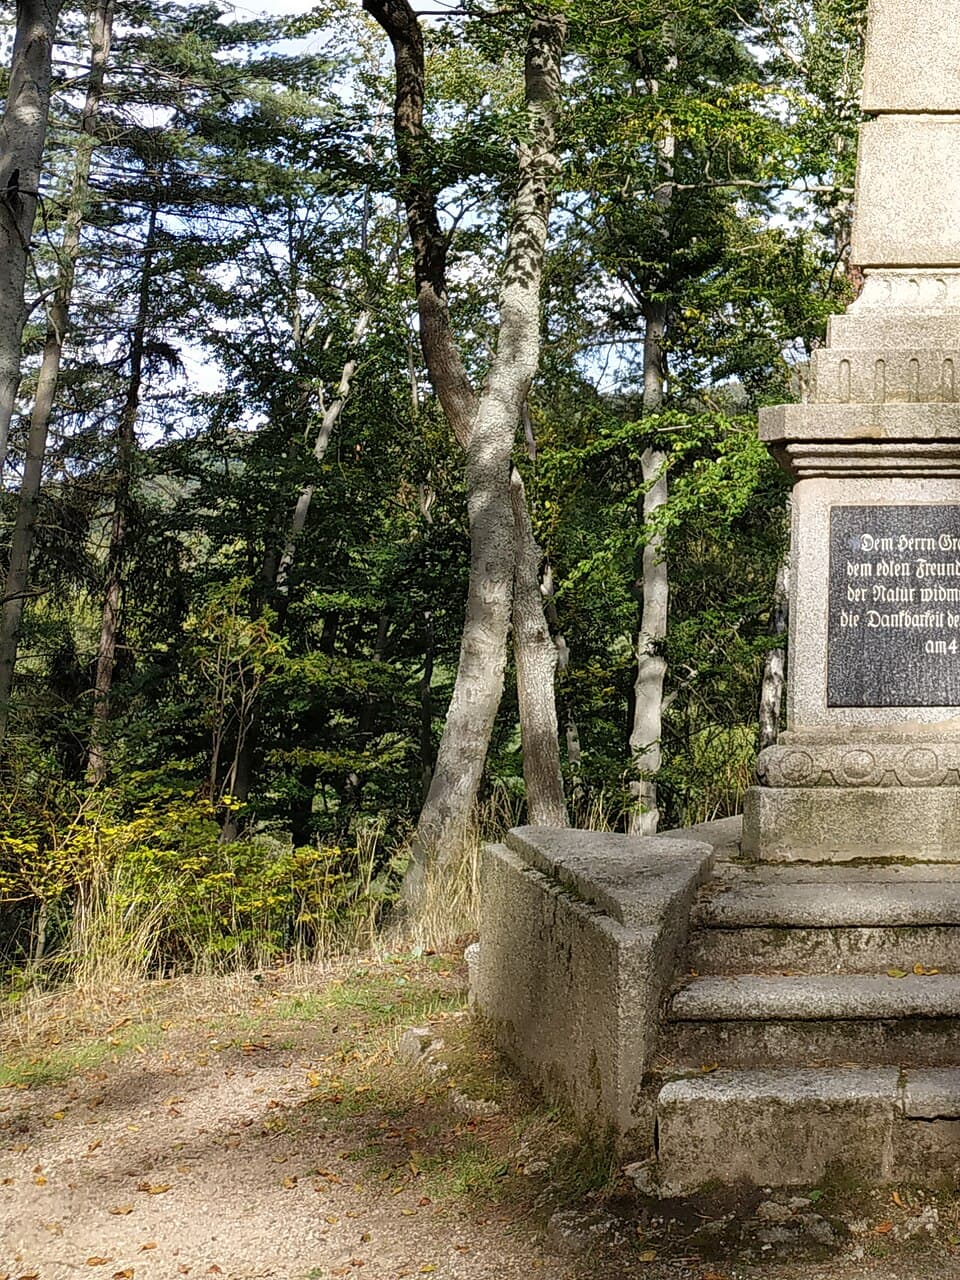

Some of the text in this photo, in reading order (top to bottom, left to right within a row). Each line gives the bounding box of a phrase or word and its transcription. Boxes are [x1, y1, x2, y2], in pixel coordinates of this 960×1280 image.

[860, 533, 893, 551] Dem
[897, 534, 936, 551] Herrn
[846, 560, 872, 577] dem
[876, 560, 910, 577] edlen
[847, 584, 868, 601] der
[872, 585, 915, 602] Natur
[839, 610, 860, 627] die
[866, 610, 944, 628] Dankbarkeit
[925, 639, 947, 655] am
[948, 637, 958, 654] 4
